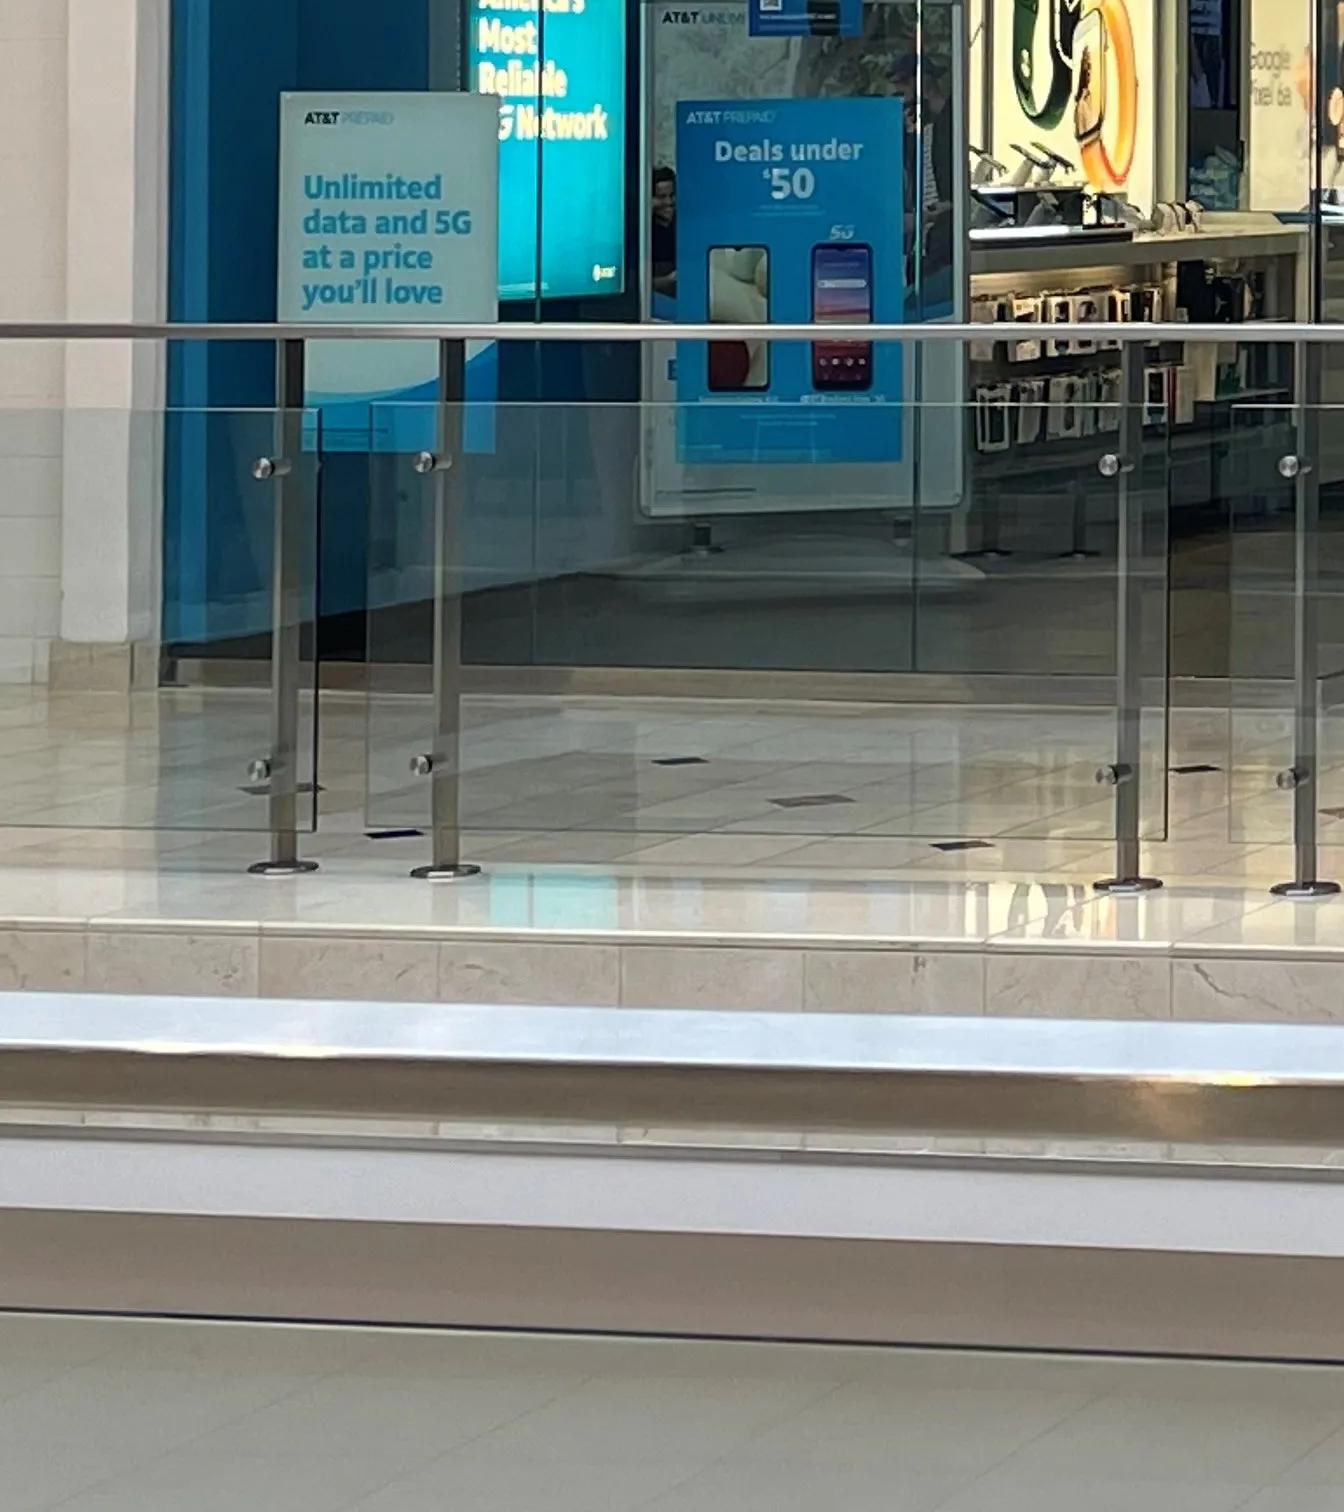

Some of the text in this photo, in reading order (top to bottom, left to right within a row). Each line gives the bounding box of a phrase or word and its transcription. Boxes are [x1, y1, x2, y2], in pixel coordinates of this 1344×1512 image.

[662, 12, 700, 25] AT&T
[478, 15, 538, 55] Most
[304, 111, 341, 125] AT&T
[686, 111, 722, 125] AT&T
[714, 138, 865, 163] Deals under
[303, 173, 442, 201] Unlimited
[302, 208, 472, 235] data and 5G
[302, 242, 433, 276] at a price
[301, 277, 443, 312] you'll love
